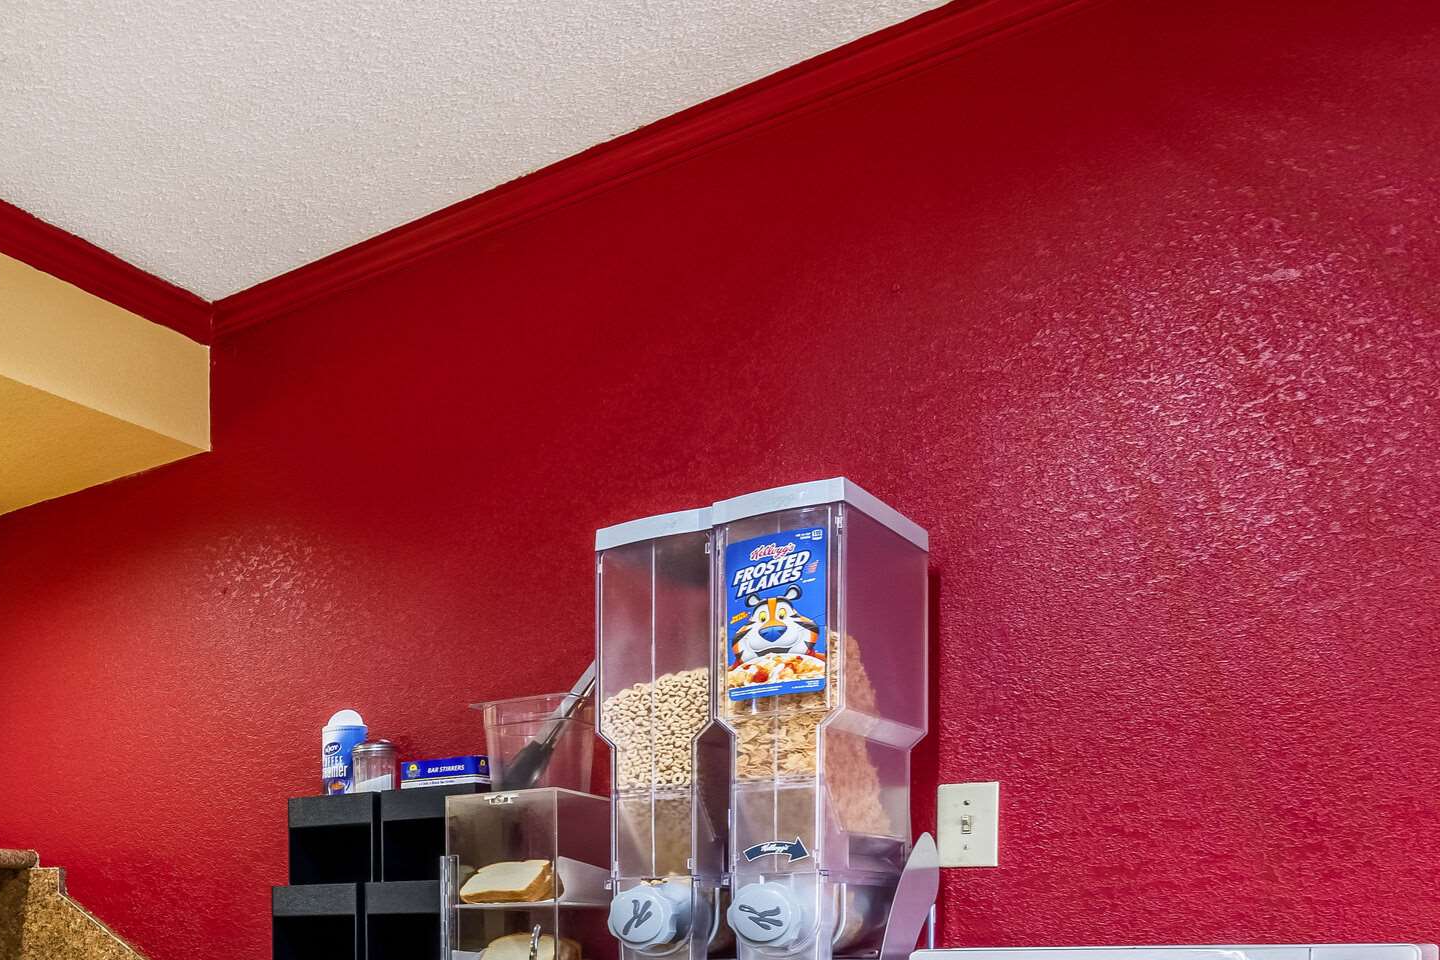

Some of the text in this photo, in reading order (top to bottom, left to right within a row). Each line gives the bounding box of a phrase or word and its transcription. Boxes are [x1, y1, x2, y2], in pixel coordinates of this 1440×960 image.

[732, 550, 811, 586] FROSTED
[737, 565, 804, 598] FLAKES
[427, 764, 465, 774] BAR STIRRERS
